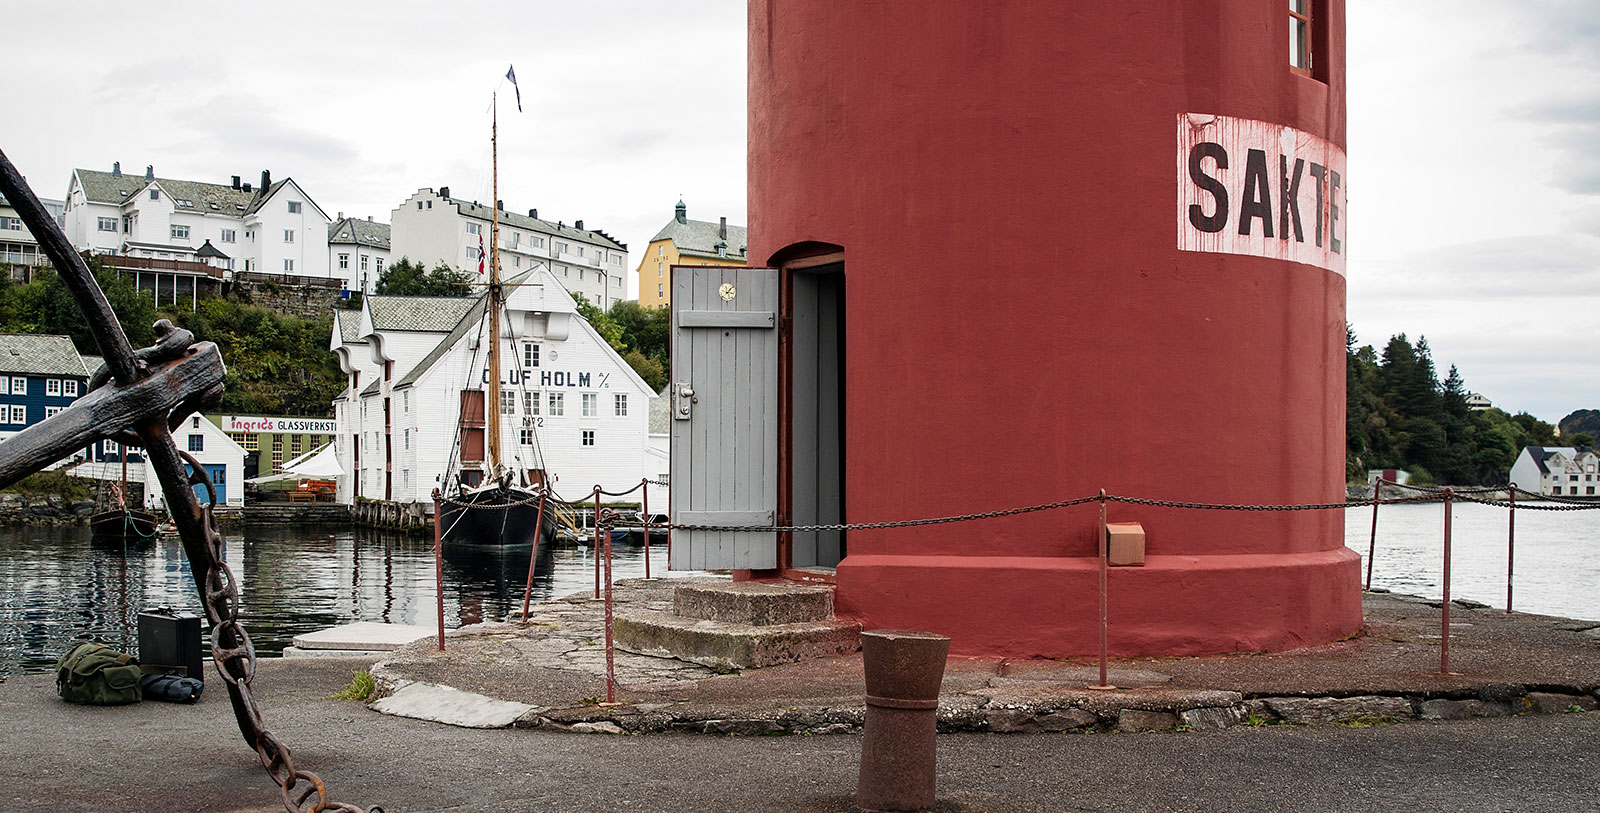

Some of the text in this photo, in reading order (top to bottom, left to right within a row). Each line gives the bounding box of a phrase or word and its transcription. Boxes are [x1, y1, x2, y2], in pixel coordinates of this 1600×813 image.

[1189, 142, 1341, 254] SAKTE
[541, 371, 590, 387] HOLM
[277, 420, 336, 431] GLASSVERKST
